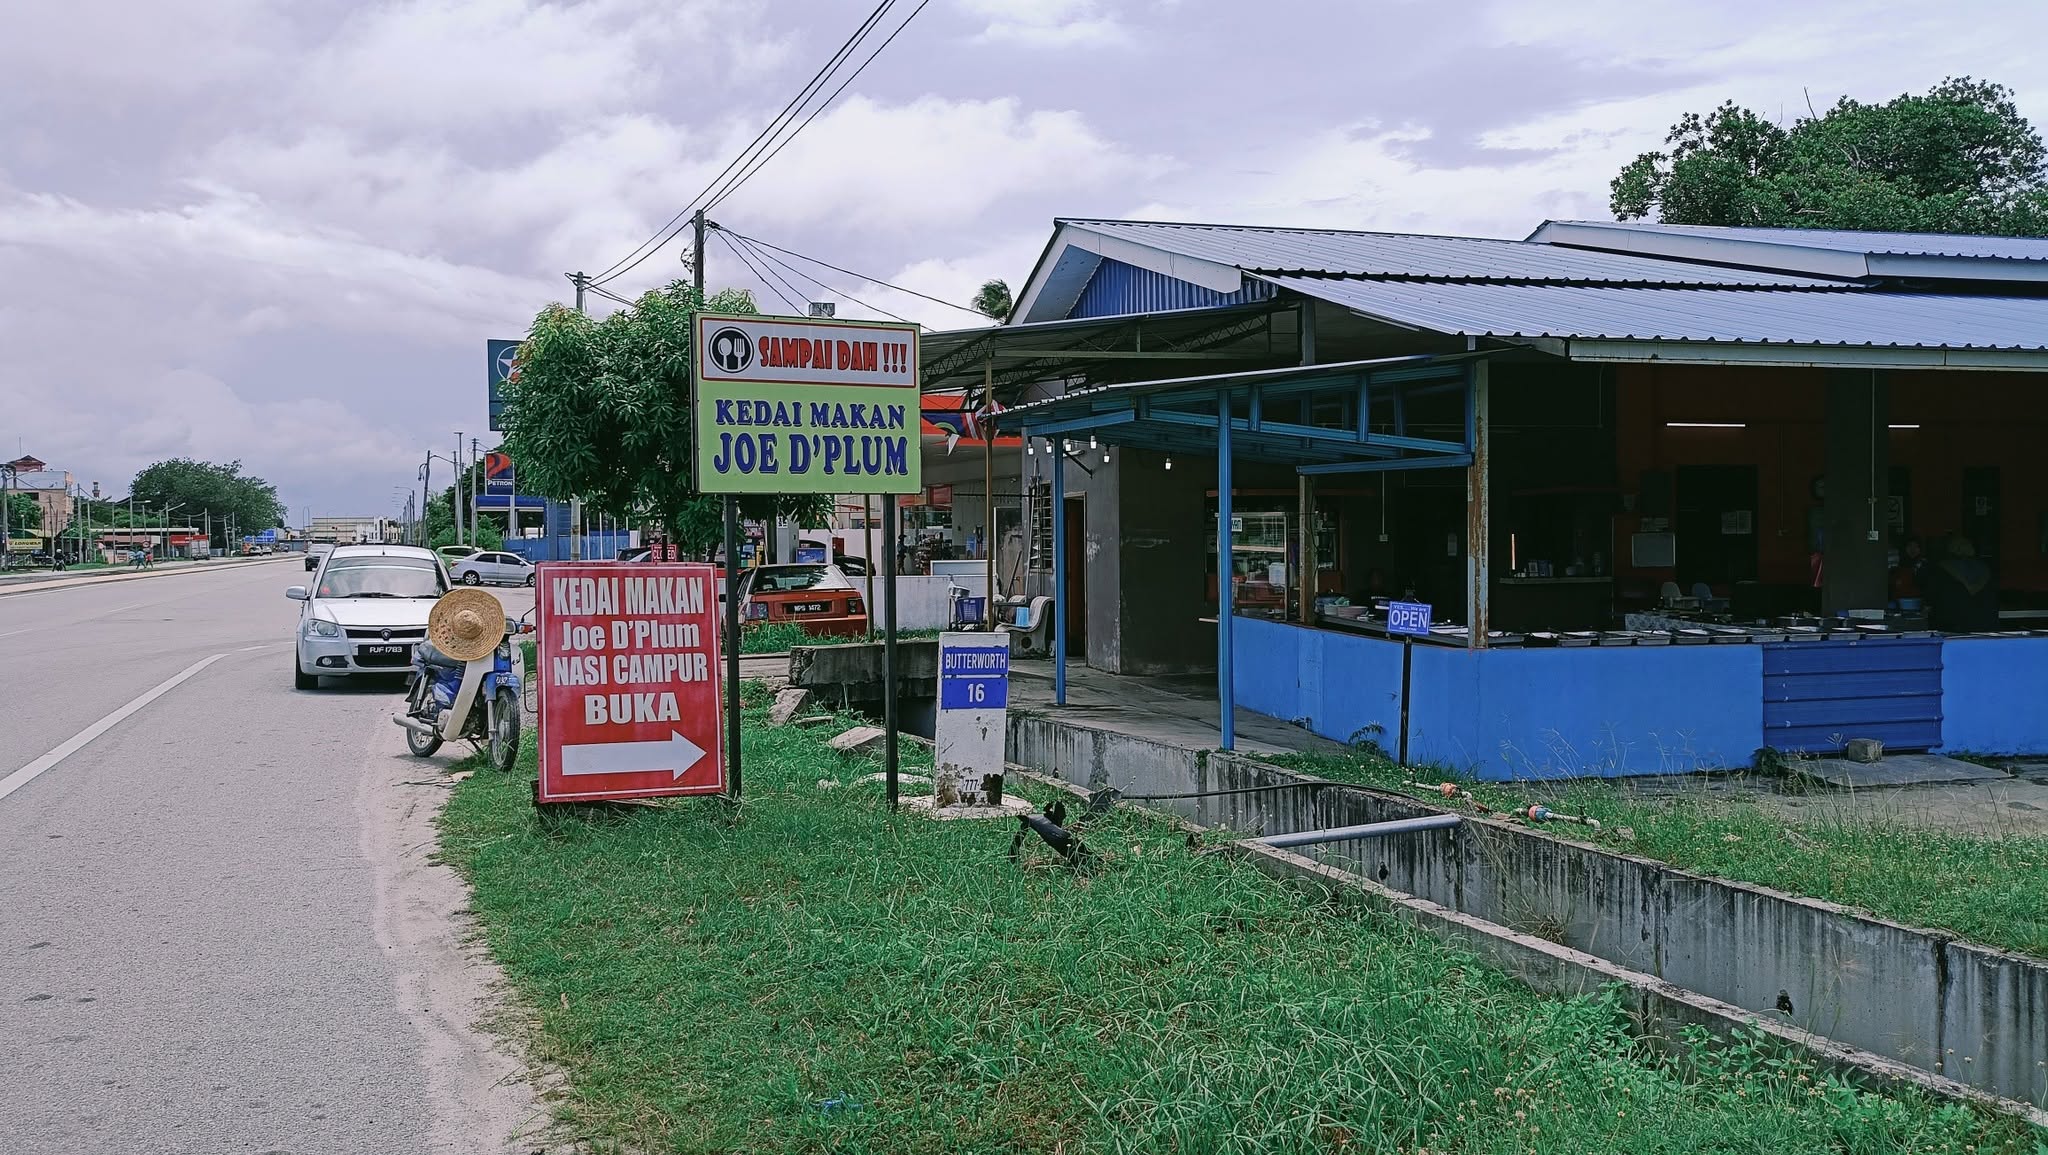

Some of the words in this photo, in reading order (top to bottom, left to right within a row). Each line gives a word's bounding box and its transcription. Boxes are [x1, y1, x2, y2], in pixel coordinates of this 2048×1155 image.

[758, 336, 833, 370] SAMPAI
[837, 339, 878, 372] DAH
[883, 343, 907, 373] !!!
[715, 399, 803, 427] KEDAI
[810, 402, 906, 430] MAKAN
[713, 432, 780, 475] JOE
[788, 433, 909, 475] D'PLUM
[552, 577, 620, 616] KEDAI
[624, 576, 705, 615] MAKAN
[561, 621, 606, 651] Joe
[611, 619, 701, 650] D'Plum
[1392, 610, 1428, 628] OPEN
[553, 655, 607, 687] NASI
[612, 652, 708, 685] CAMPUR
[945, 653, 1006, 670] BUTTERWORTH
[584, 692, 681, 725] BUKA
[967, 683, 985, 703] 16
